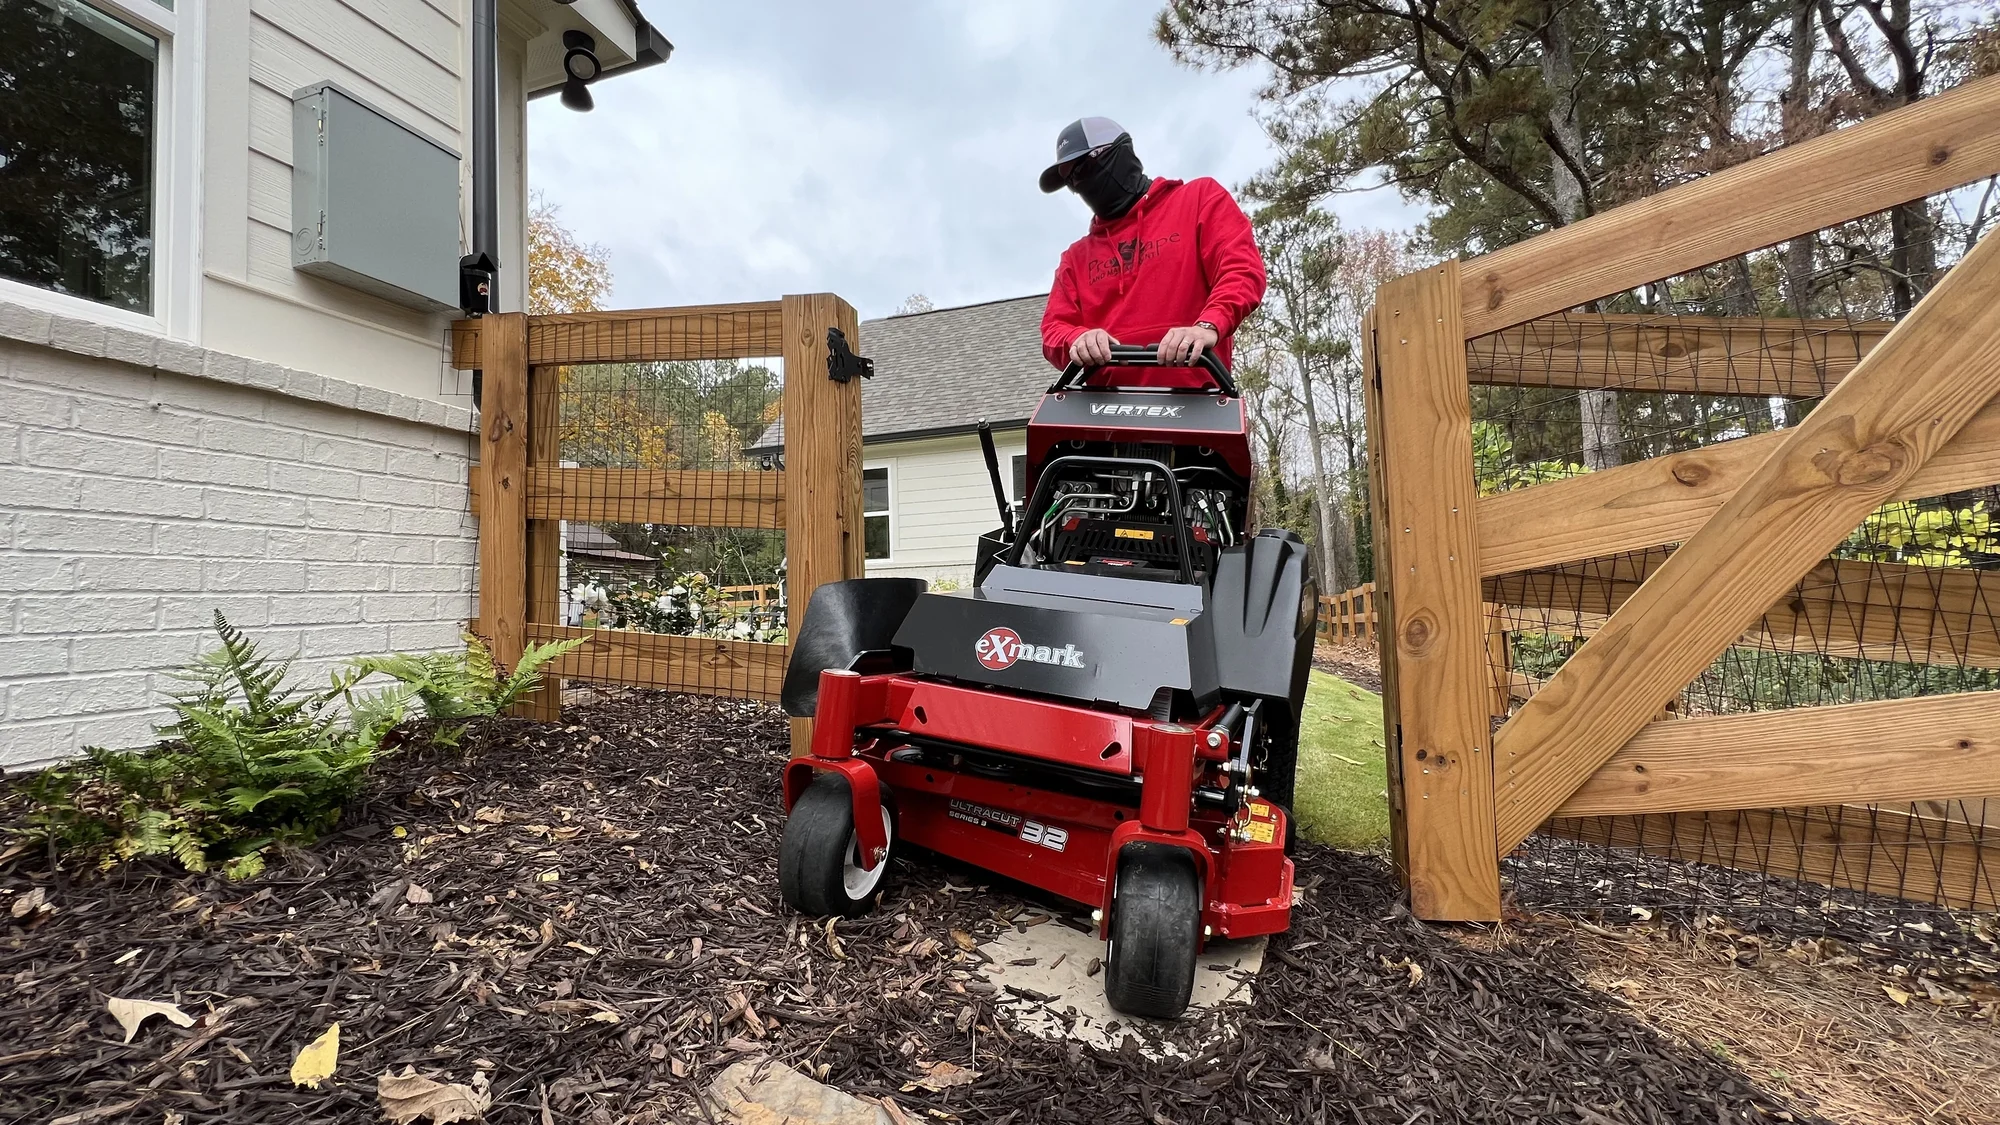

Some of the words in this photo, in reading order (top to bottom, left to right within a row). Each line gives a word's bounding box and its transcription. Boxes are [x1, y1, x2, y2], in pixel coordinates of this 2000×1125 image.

[1090, 403, 1182, 417] VERTEX
[950, 799, 1020, 827] ULTRACUT
[1020, 820, 1068, 852] 32
